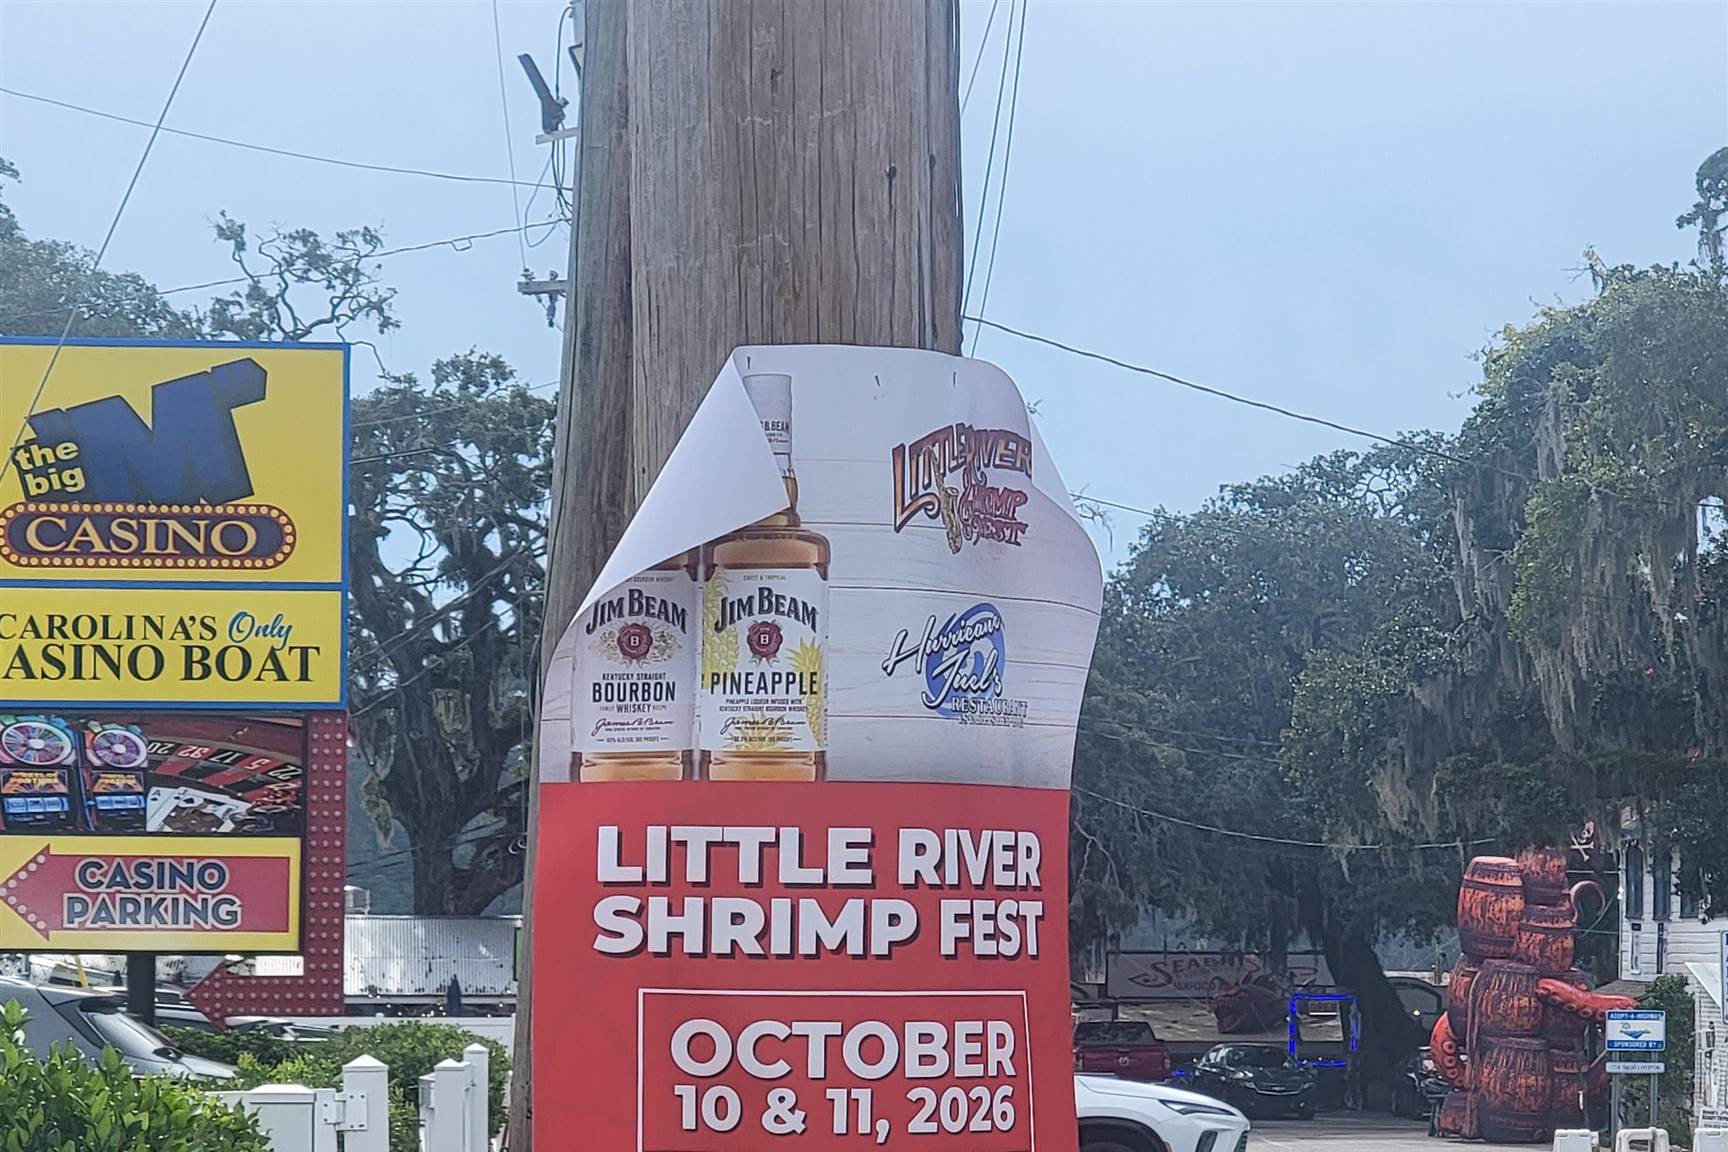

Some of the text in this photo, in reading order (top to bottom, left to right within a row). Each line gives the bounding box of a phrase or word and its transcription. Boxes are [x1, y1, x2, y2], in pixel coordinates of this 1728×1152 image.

[14, 441, 79, 470] the
[25, 466, 85, 496] big
[25, 517, 257, 555] CASINO
[585, 588, 688, 635] JIM BEAM
[714, 587, 818, 633] JIM BEAM
[228, 611, 294, 650] Only
[2, 643, 320, 682] ASINO BOAT
[592, 681, 676, 703] BOURBON
[710, 671, 818, 696] PINEAPPLE
[616, 703, 652, 713] WHISKEY
[76, 859, 228, 891] CASINO
[597, 825, 1042, 889] LITTLE RIVER
[65, 895, 241, 926] PARKING
[593, 895, 1045, 960] SHRIMP FEST
[670, 1018, 1016, 1080] OCTOBER
[674, 1084, 1016, 1144] 10 & 11, 2026
